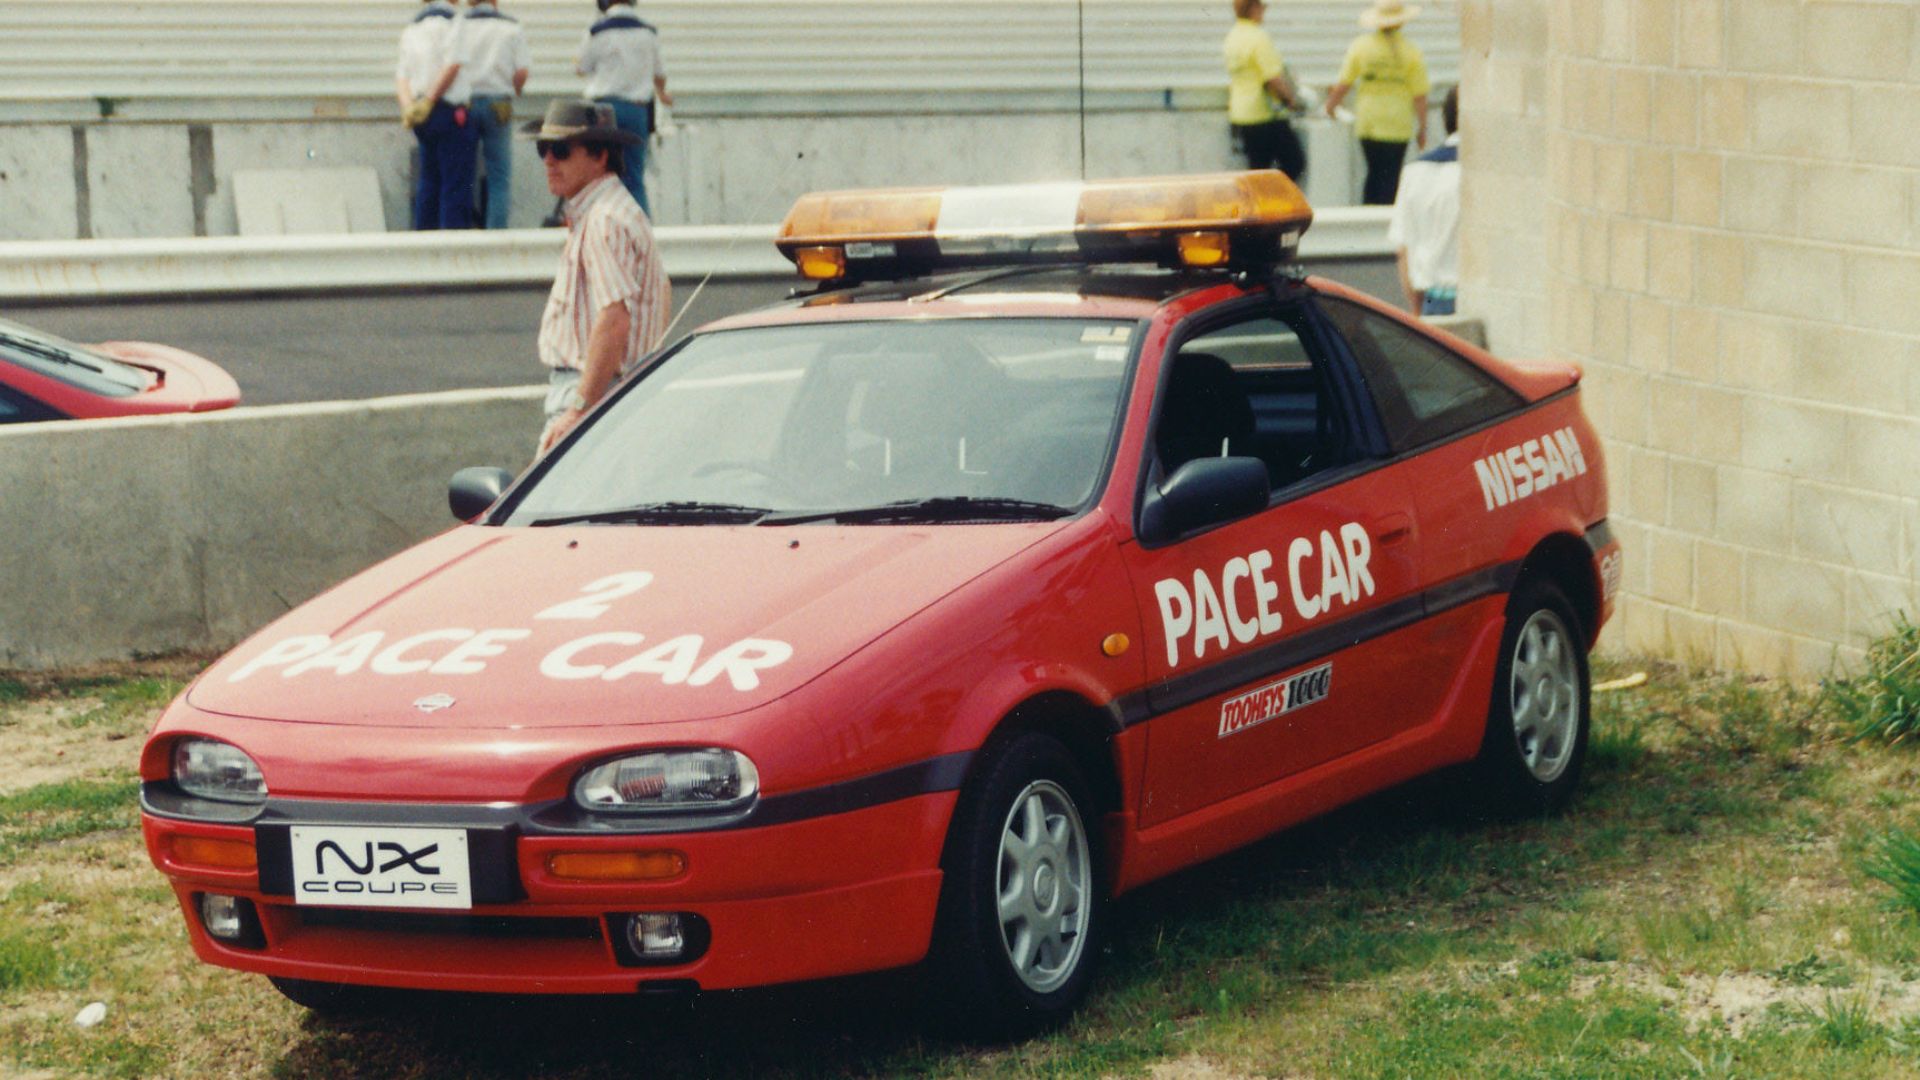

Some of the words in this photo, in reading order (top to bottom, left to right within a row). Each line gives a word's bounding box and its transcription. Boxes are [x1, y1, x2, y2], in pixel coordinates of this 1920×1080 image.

[1474, 426, 1587, 512] NISSAN
[533, 571, 654, 620] 2
[1154, 549, 1283, 668] PACE
[1288, 522, 1376, 619] CAR
[227, 628, 533, 683] PACE
[539, 631, 794, 691] CAR
[1222, 683, 1286, 733] TOOHEYS
[1287, 667, 1330, 709] 1000
[302, 880, 458, 894] COUPE
[315, 839, 441, 875] NX
